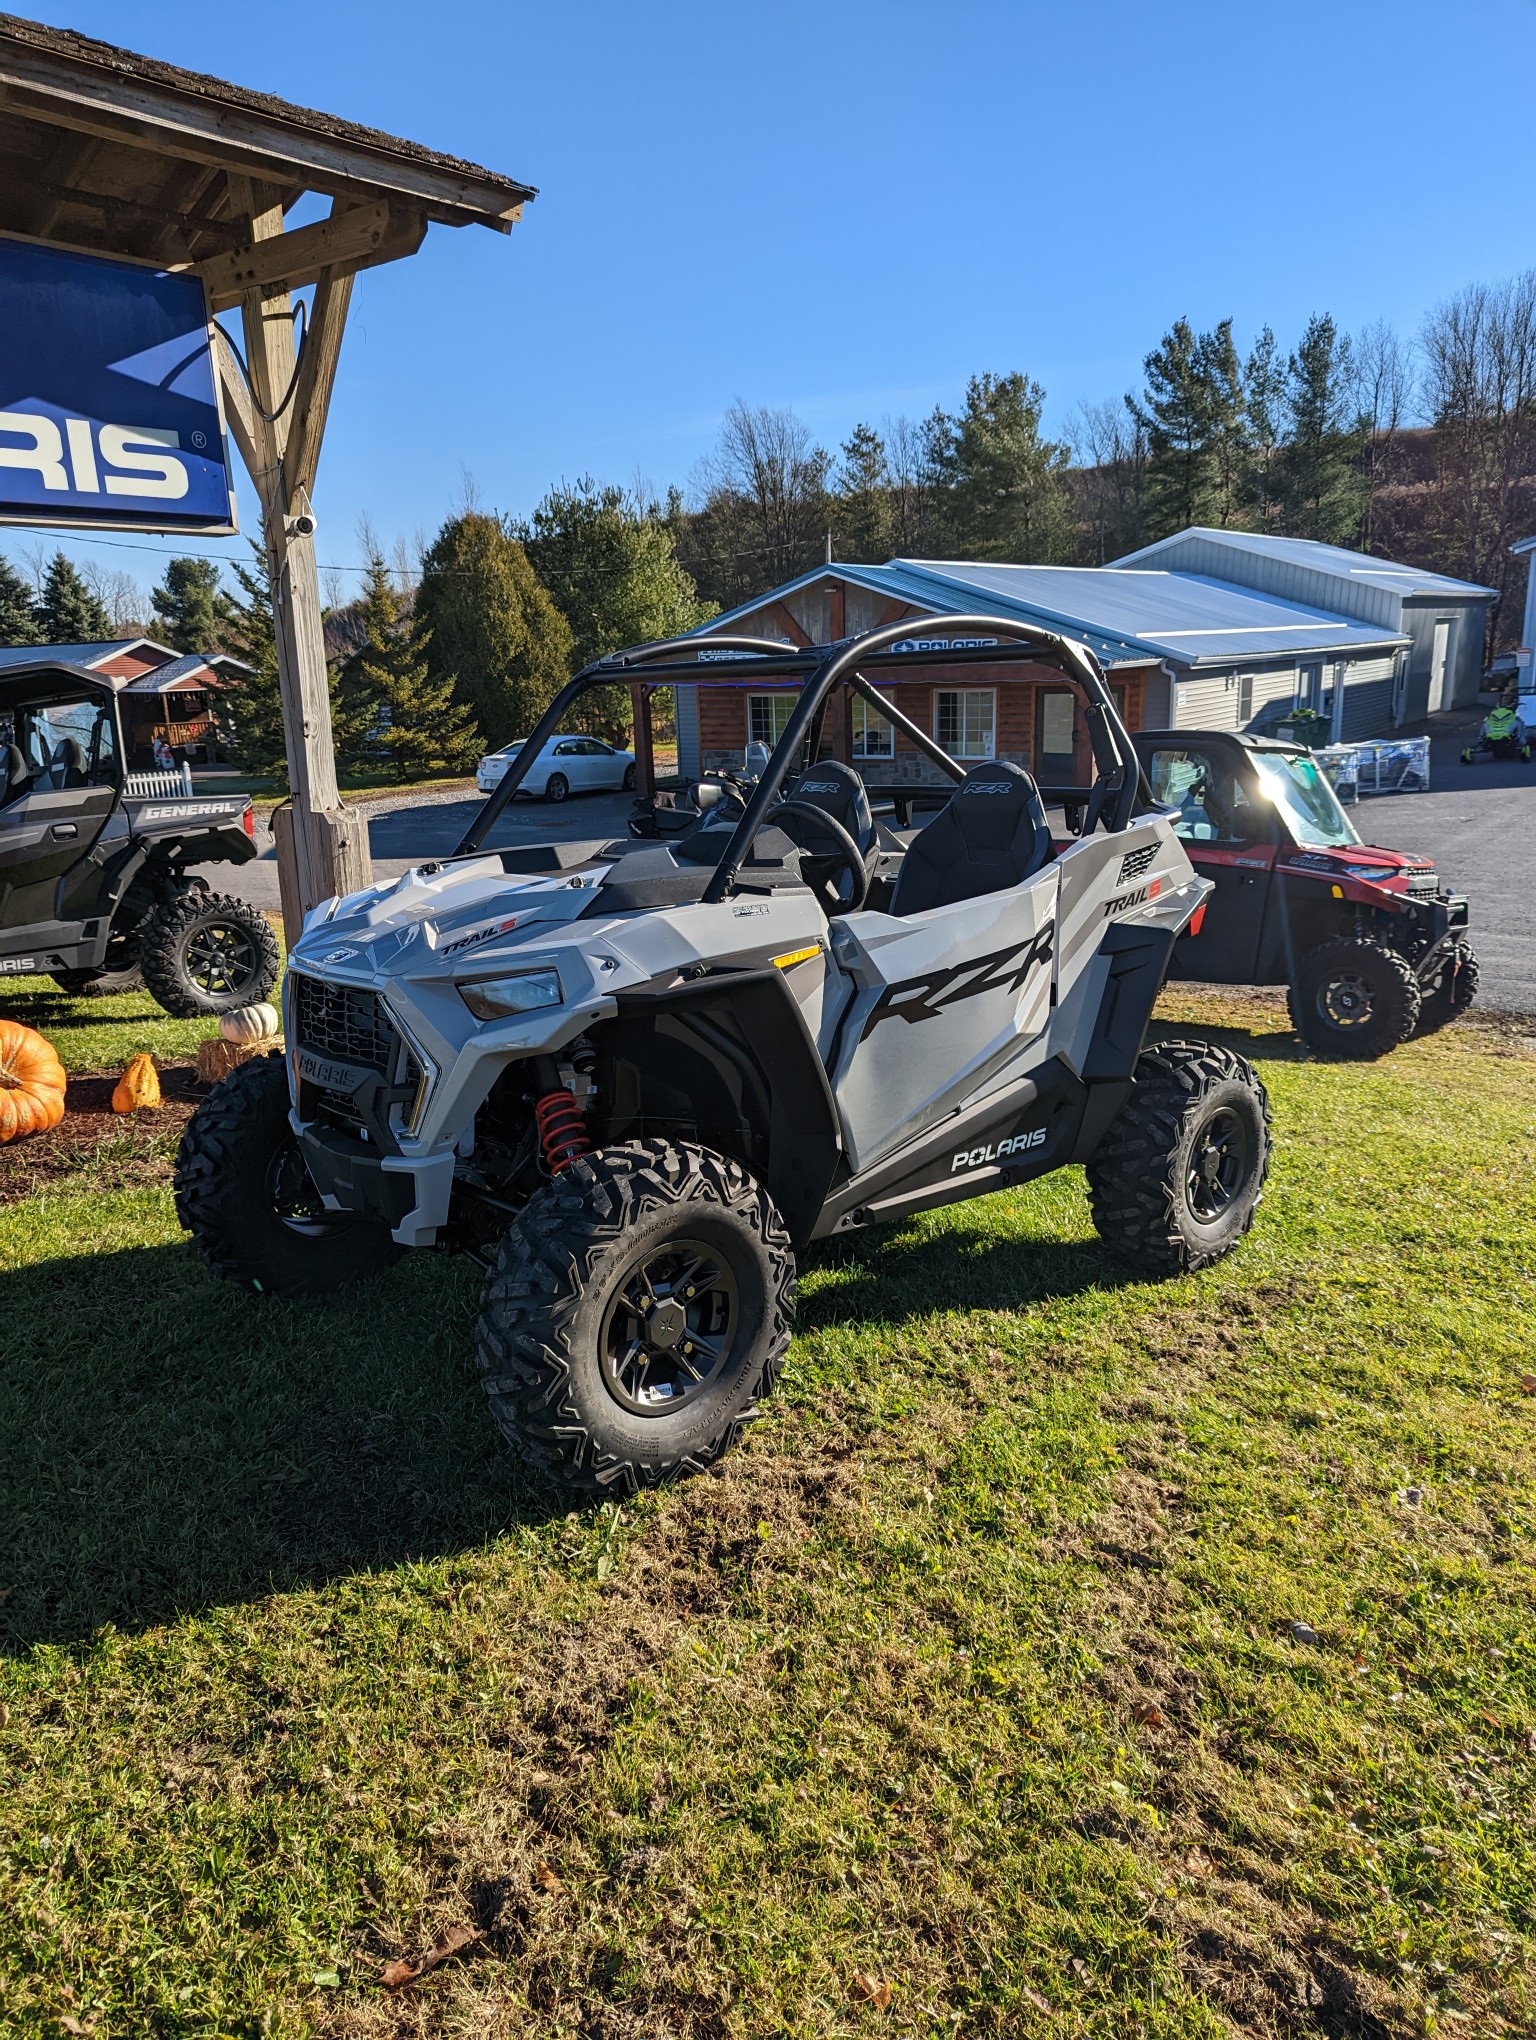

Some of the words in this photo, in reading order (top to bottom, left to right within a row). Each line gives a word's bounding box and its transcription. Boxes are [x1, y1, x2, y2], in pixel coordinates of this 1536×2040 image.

[800, 781, 841, 793] RZR
[963, 781, 1013, 795] RZR
[145, 802, 236, 820] GENERAL
[1104, 887, 1148, 917] TRAIL
[441, 926, 499, 956] TRAIL
[858, 918, 1054, 1045] RZR
[298, 1054, 357, 1088] POLARIS
[950, 1126, 1047, 1173] POLARIS
